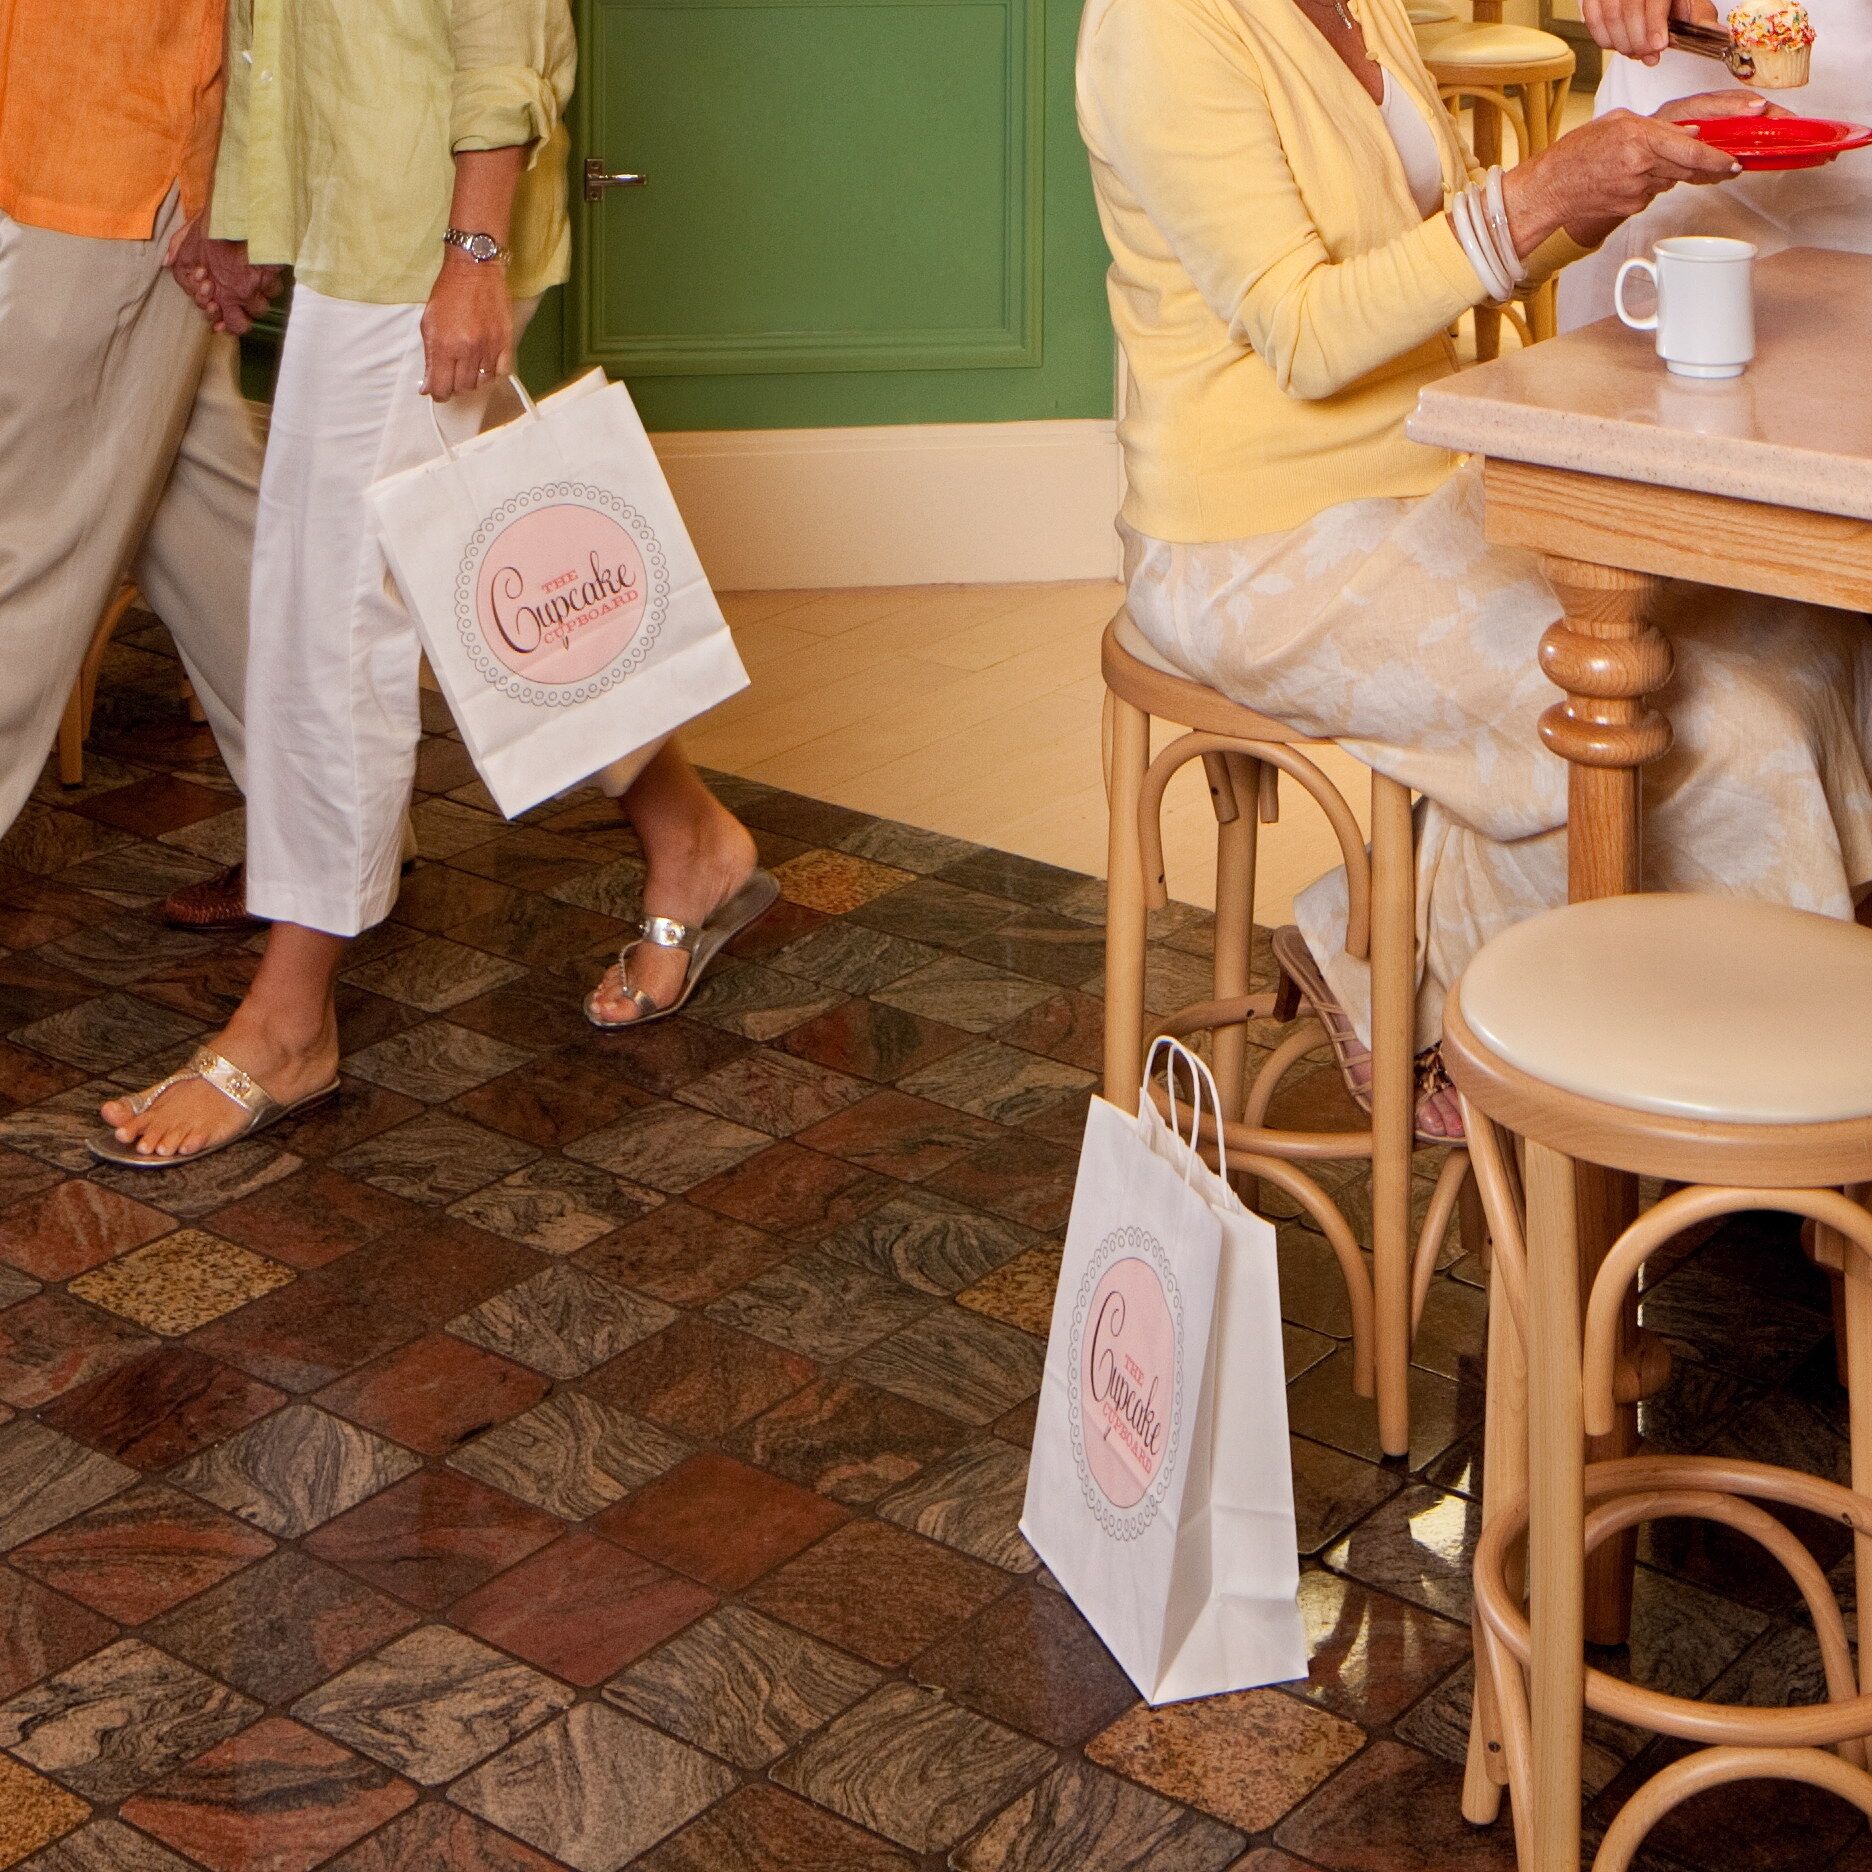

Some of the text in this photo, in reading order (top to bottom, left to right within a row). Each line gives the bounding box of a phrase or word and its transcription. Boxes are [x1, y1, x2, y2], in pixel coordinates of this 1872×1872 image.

[490, 550, 637, 654] Cupcake
[541, 569, 579, 594] THE
[544, 589, 639, 645] CUPBOARD
[1090, 1290, 1162, 1456] Cupcake
[1124, 1353, 1144, 1388] THE
[1102, 1400, 1152, 1475] CUPBOARD
